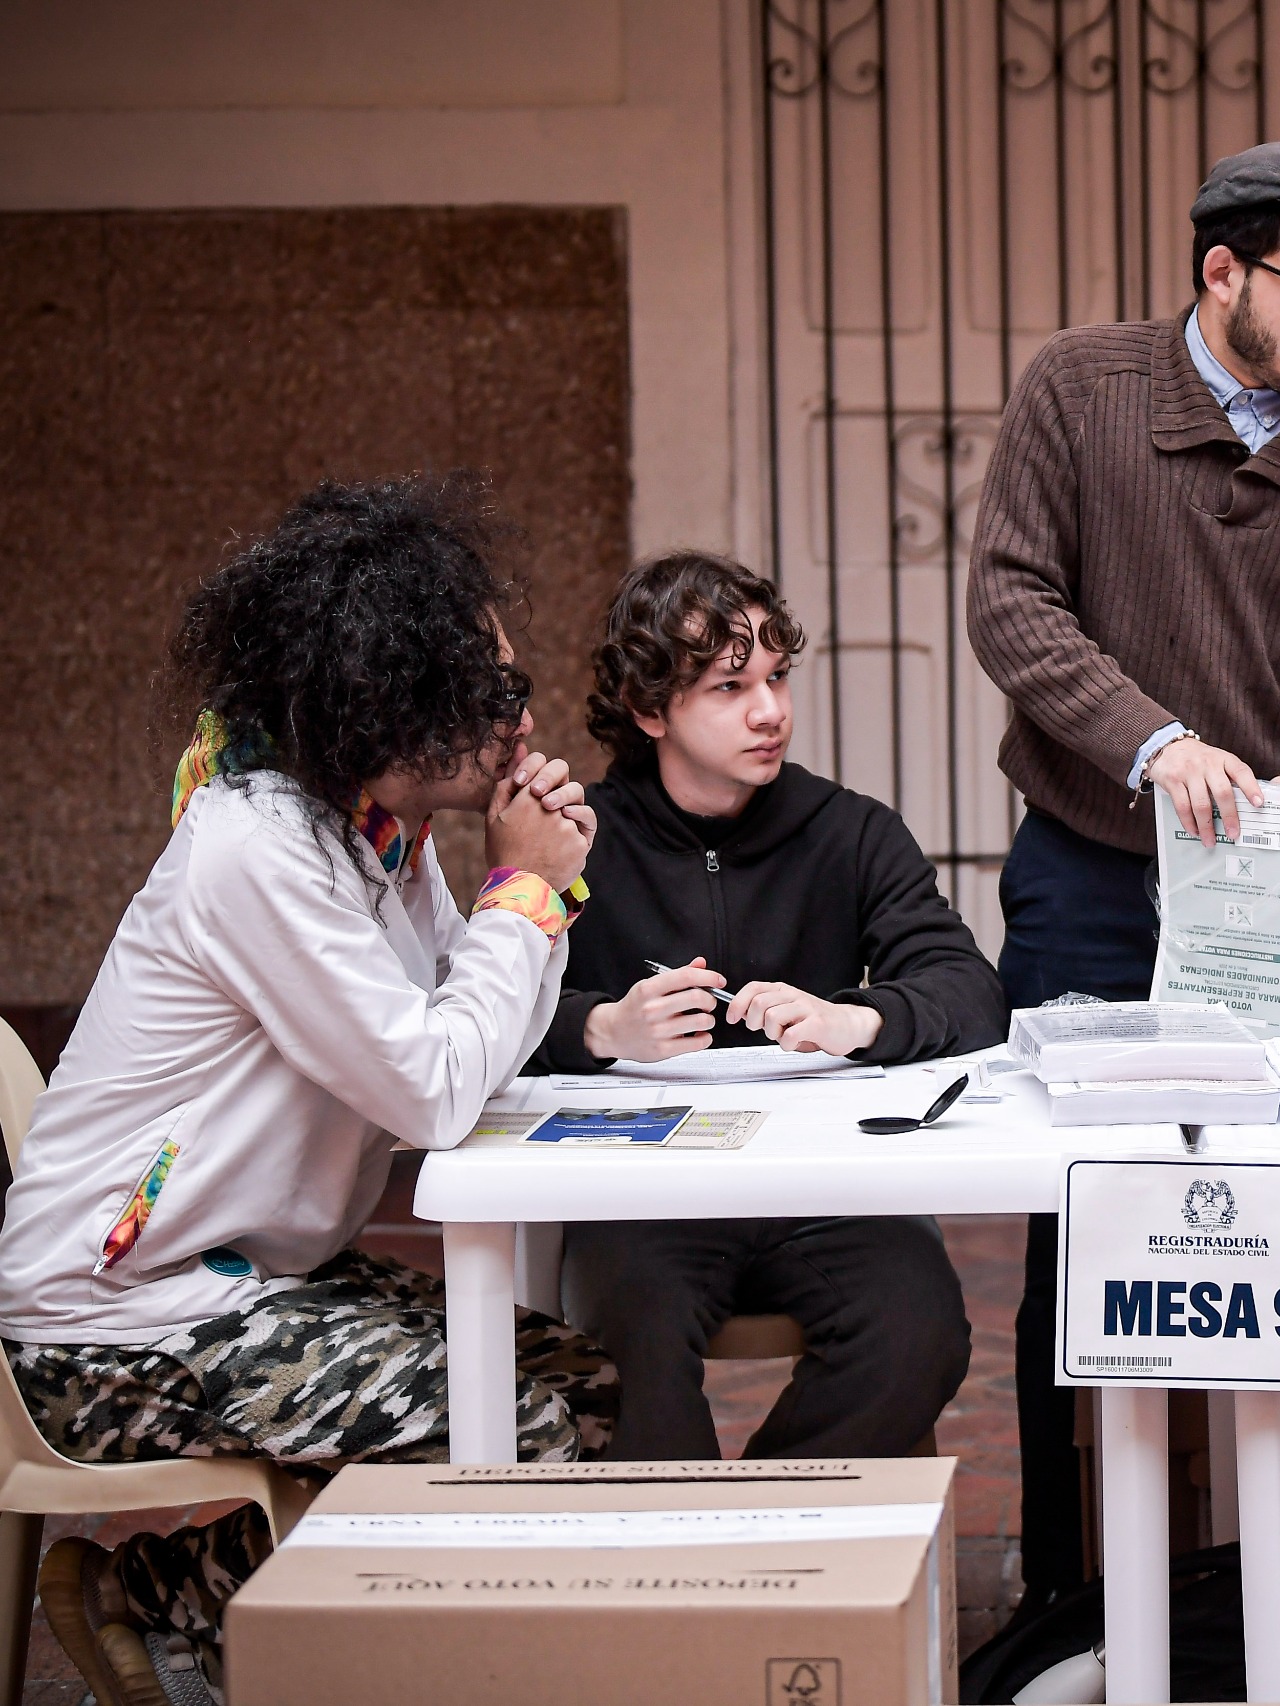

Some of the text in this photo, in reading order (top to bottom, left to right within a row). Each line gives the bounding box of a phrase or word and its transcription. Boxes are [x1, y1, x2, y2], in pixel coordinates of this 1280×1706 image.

[1199, 945, 1274, 961] INSTRUCCIONES PARA VOTA
[1179, 965, 1224, 978] INDÍGENAS
[1168, 980, 1243, 999] REPRESENTANTES
[1245, 991, 1256, 1000] DE
[1207, 997, 1252, 1011] VOTO PRA
[1148, 1234, 1270, 1249] REGISTRADURÍA
[1148, 1247, 1270, 1257] NACIONAL DEL ESTADO CIVIL
[1103, 1280, 1261, 1339] MESA
[459, 1467, 618, 1476] DEPOSITE
[462, 1578, 557, 1590] VOTO
[568, 1578, 613, 1589] SU
[622, 1578, 798, 1589] DEPOSITE
